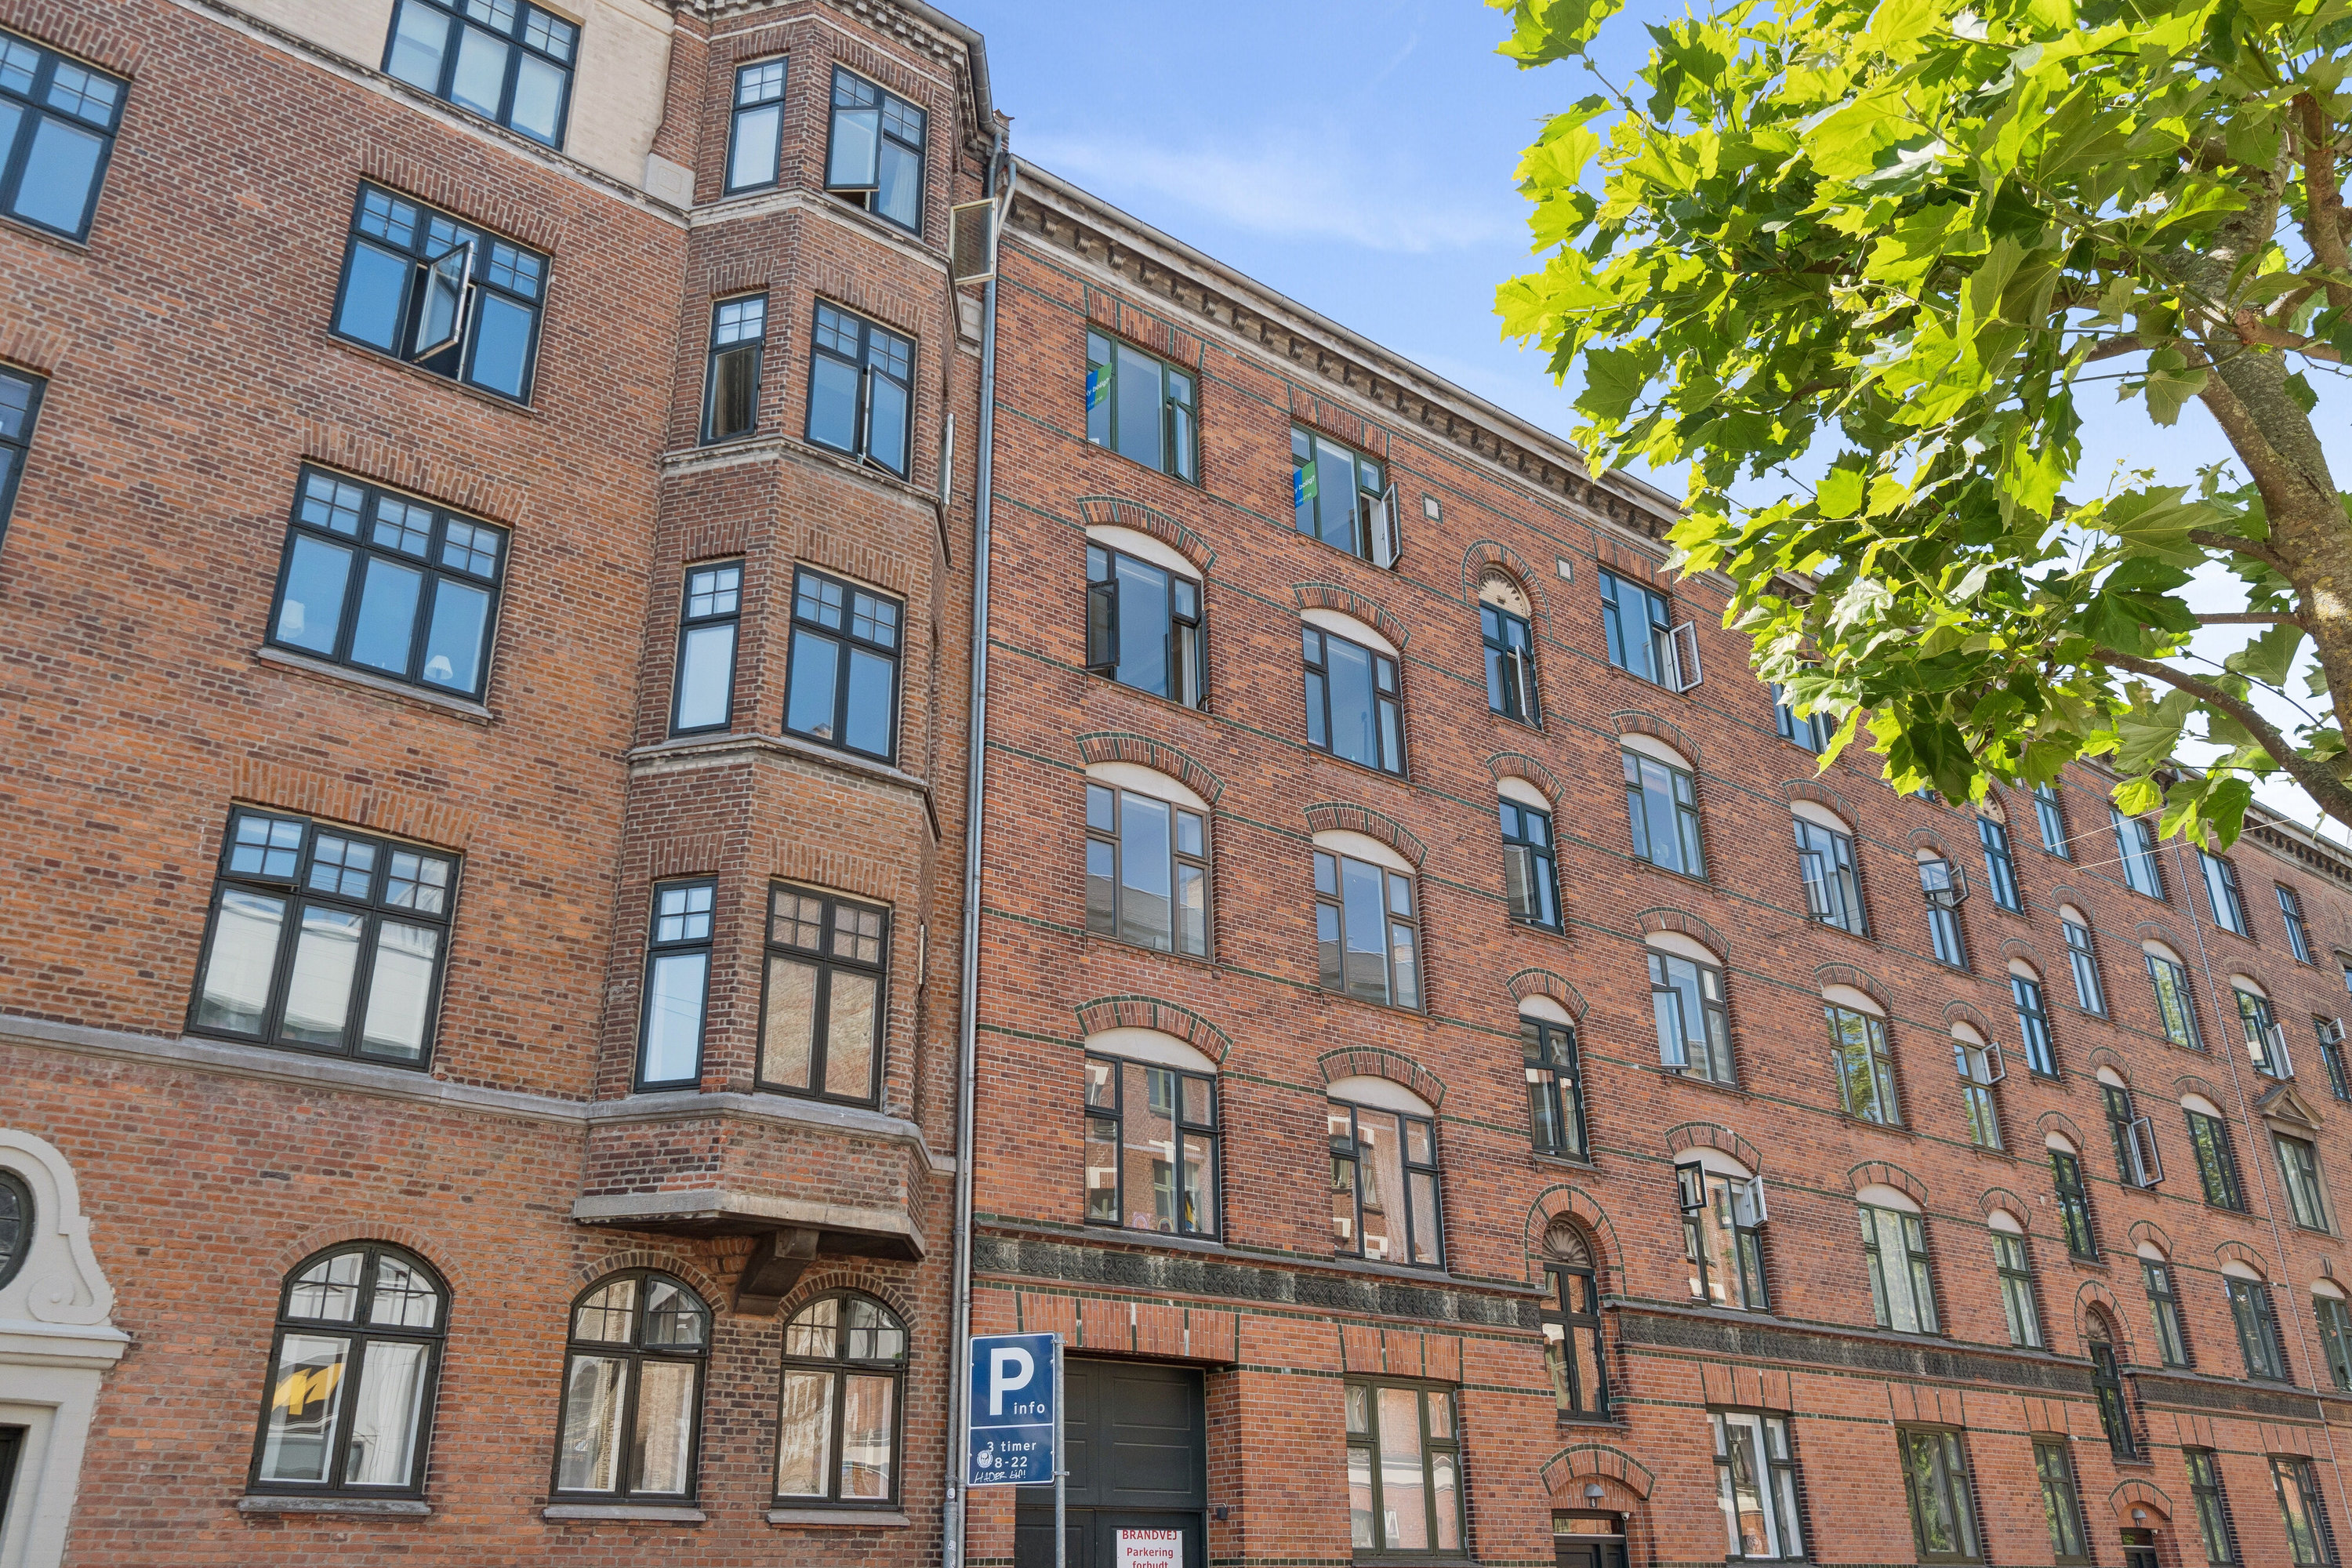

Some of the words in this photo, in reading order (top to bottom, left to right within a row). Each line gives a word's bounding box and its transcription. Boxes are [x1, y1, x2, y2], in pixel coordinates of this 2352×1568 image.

[1092, 377, 1109, 392] bolig?
[1298, 475, 1315, 490] bolig?
[989, 1347, 1034, 1416] P
[1014, 1401, 1045, 1414] info
[987, 1441, 994, 1452] 3
[1000, 1441, 1036, 1452] timer
[994, 1456, 1028, 1468] 8-22
[1122, 1530, 1177, 1540] BRANDVEJ
[1127, 1547, 1174, 1559] Parkering
